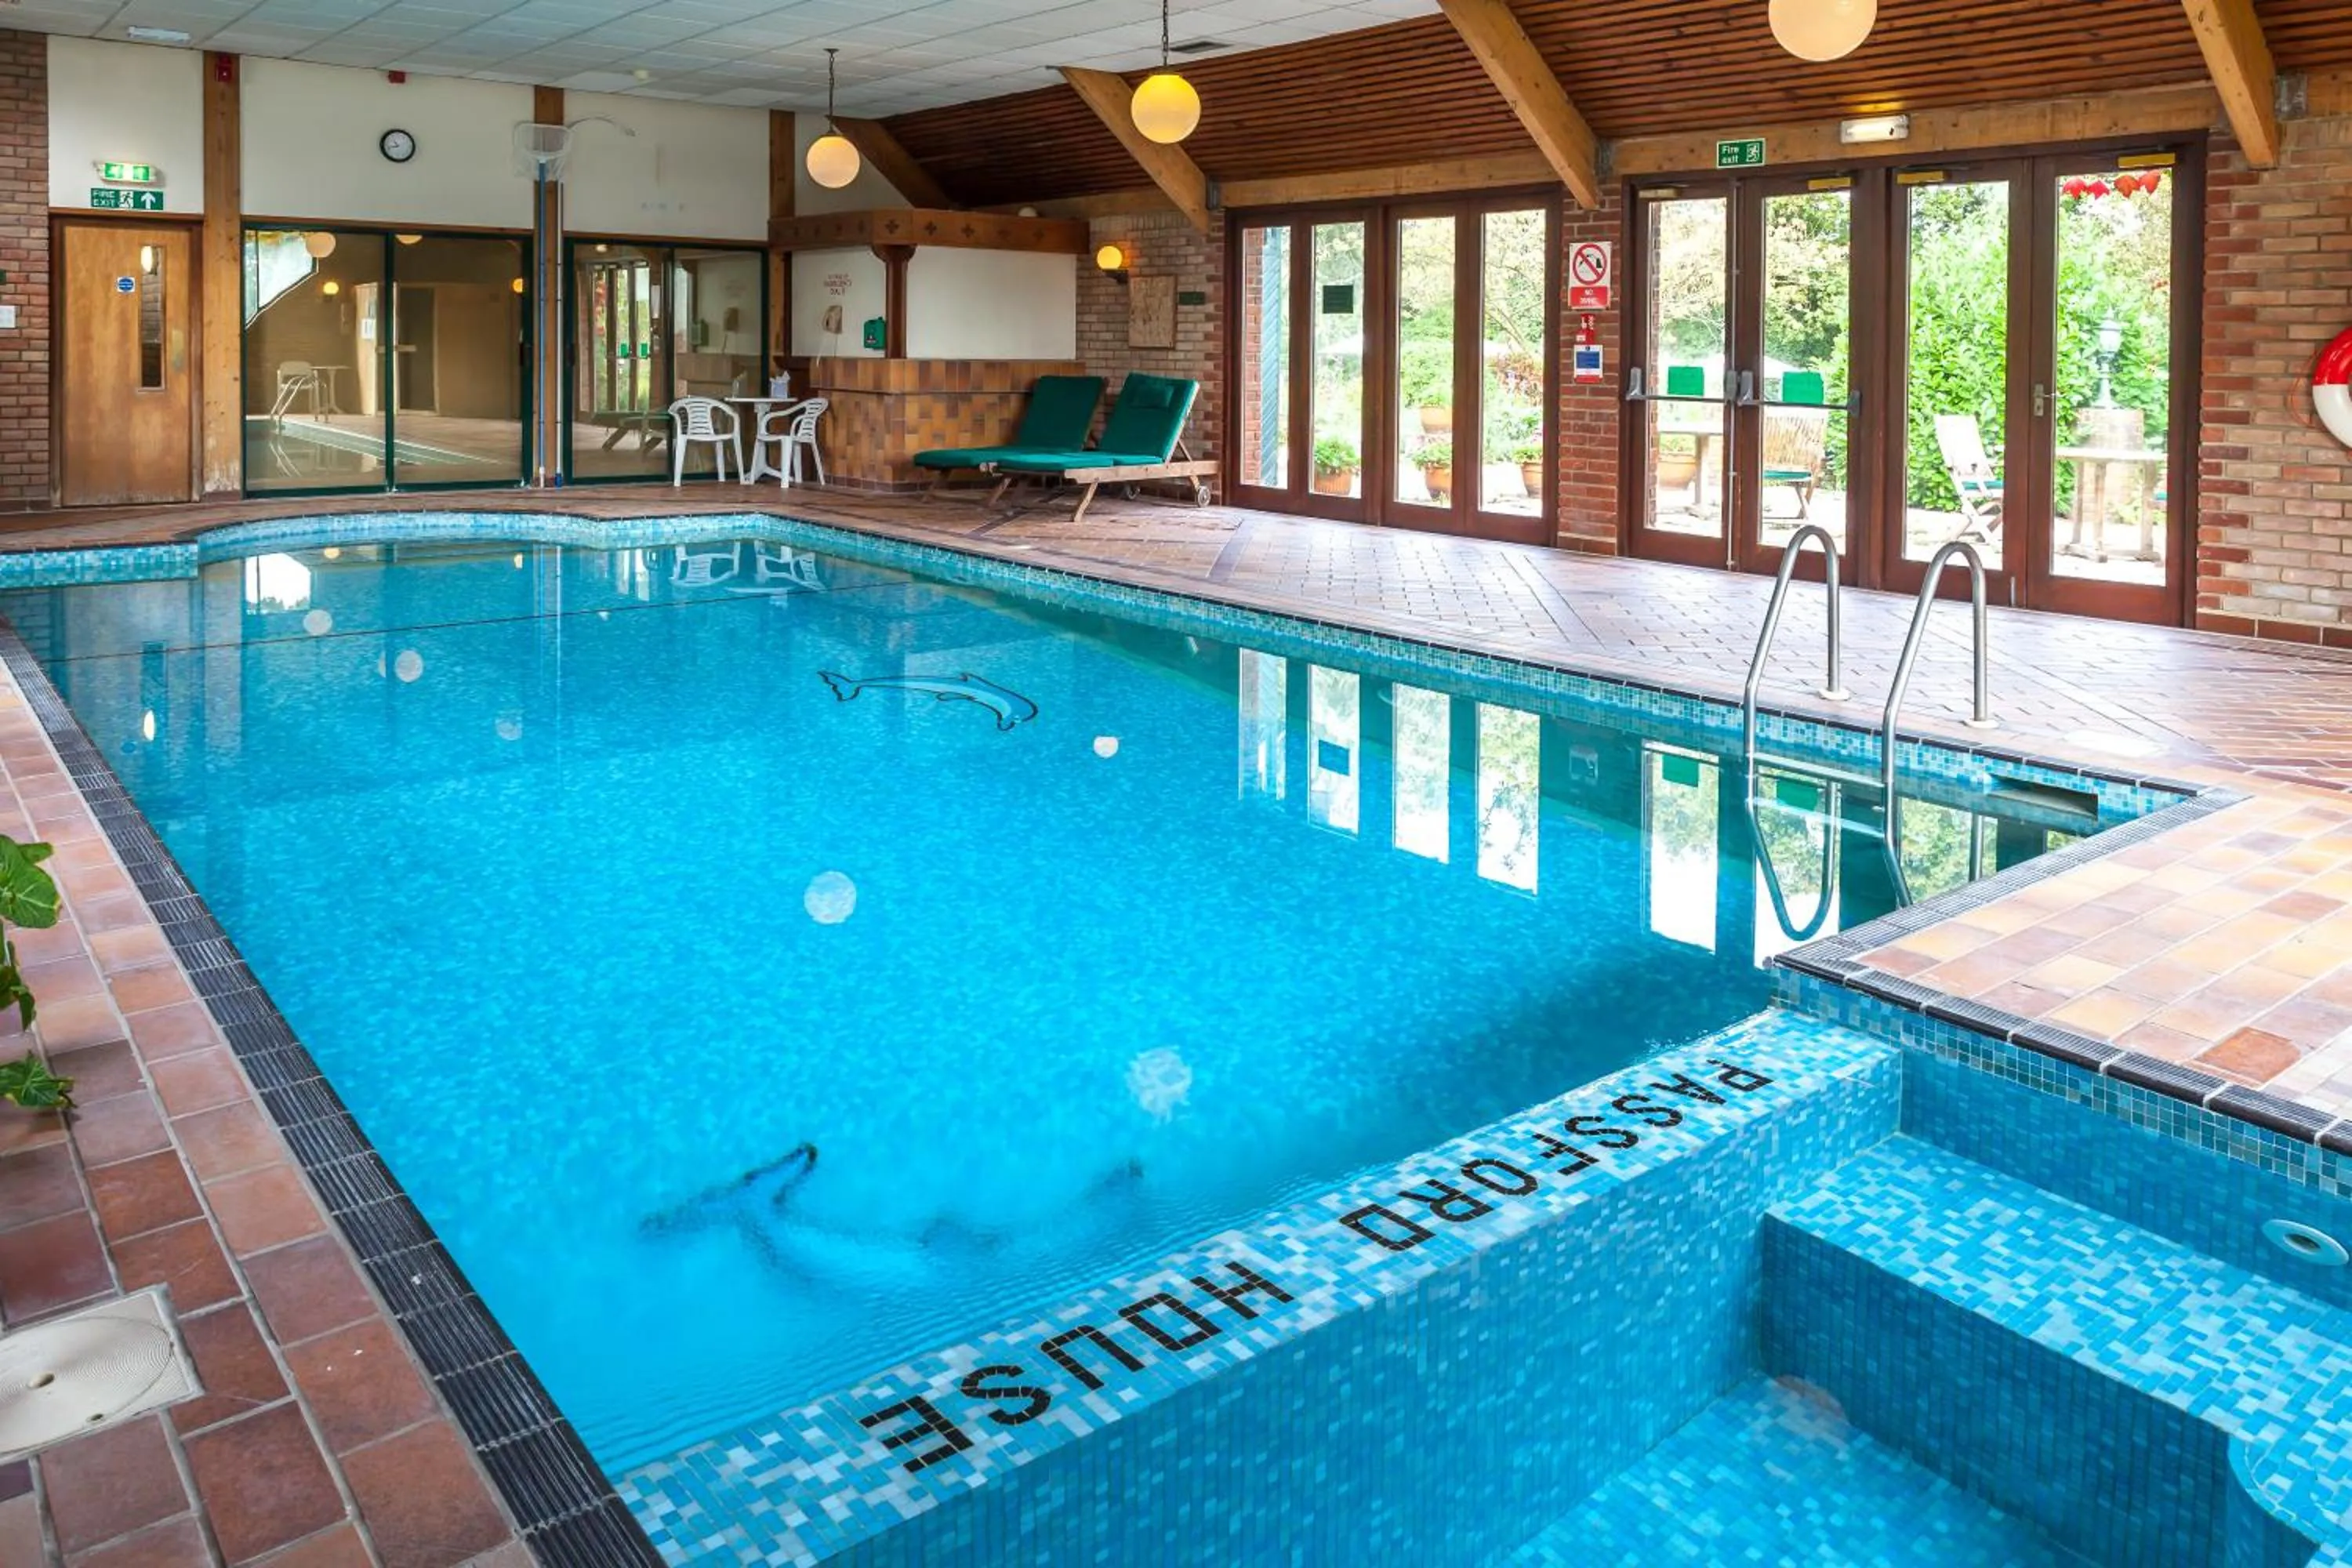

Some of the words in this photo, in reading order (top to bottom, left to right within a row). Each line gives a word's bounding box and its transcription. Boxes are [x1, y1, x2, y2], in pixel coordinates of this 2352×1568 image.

[1722, 145, 1740, 154] Fire
[1722, 154, 1738, 164] exit
[93, 189, 115, 198] FIRE
[93, 198, 115, 208] EXIT
[1339, 1059, 1774, 1251] PASSFORD
[859, 1261, 1294, 1473] HOUSE
